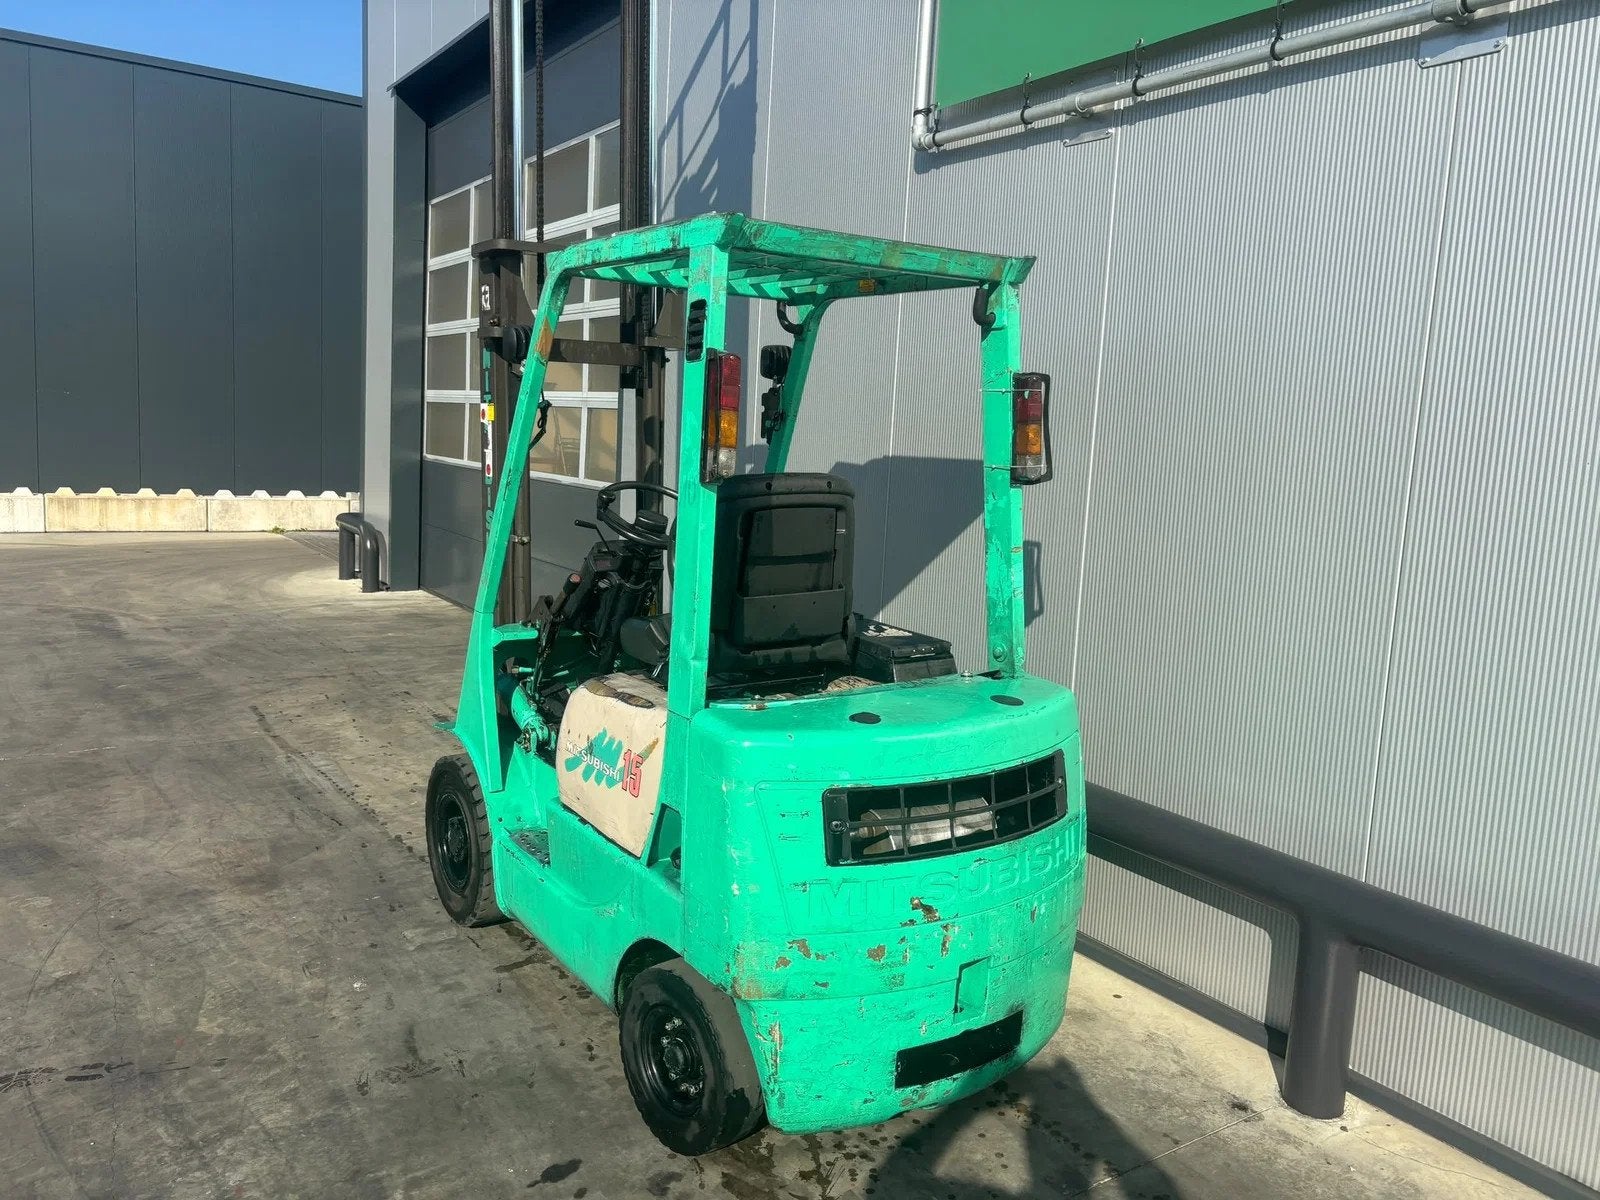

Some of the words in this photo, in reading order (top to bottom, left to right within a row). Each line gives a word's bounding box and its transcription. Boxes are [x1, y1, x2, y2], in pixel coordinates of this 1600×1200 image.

[566, 741, 621, 782] MITSUBISHI
[621, 748, 644, 798] 15
[808, 825, 1076, 918] MITSUBISHI
